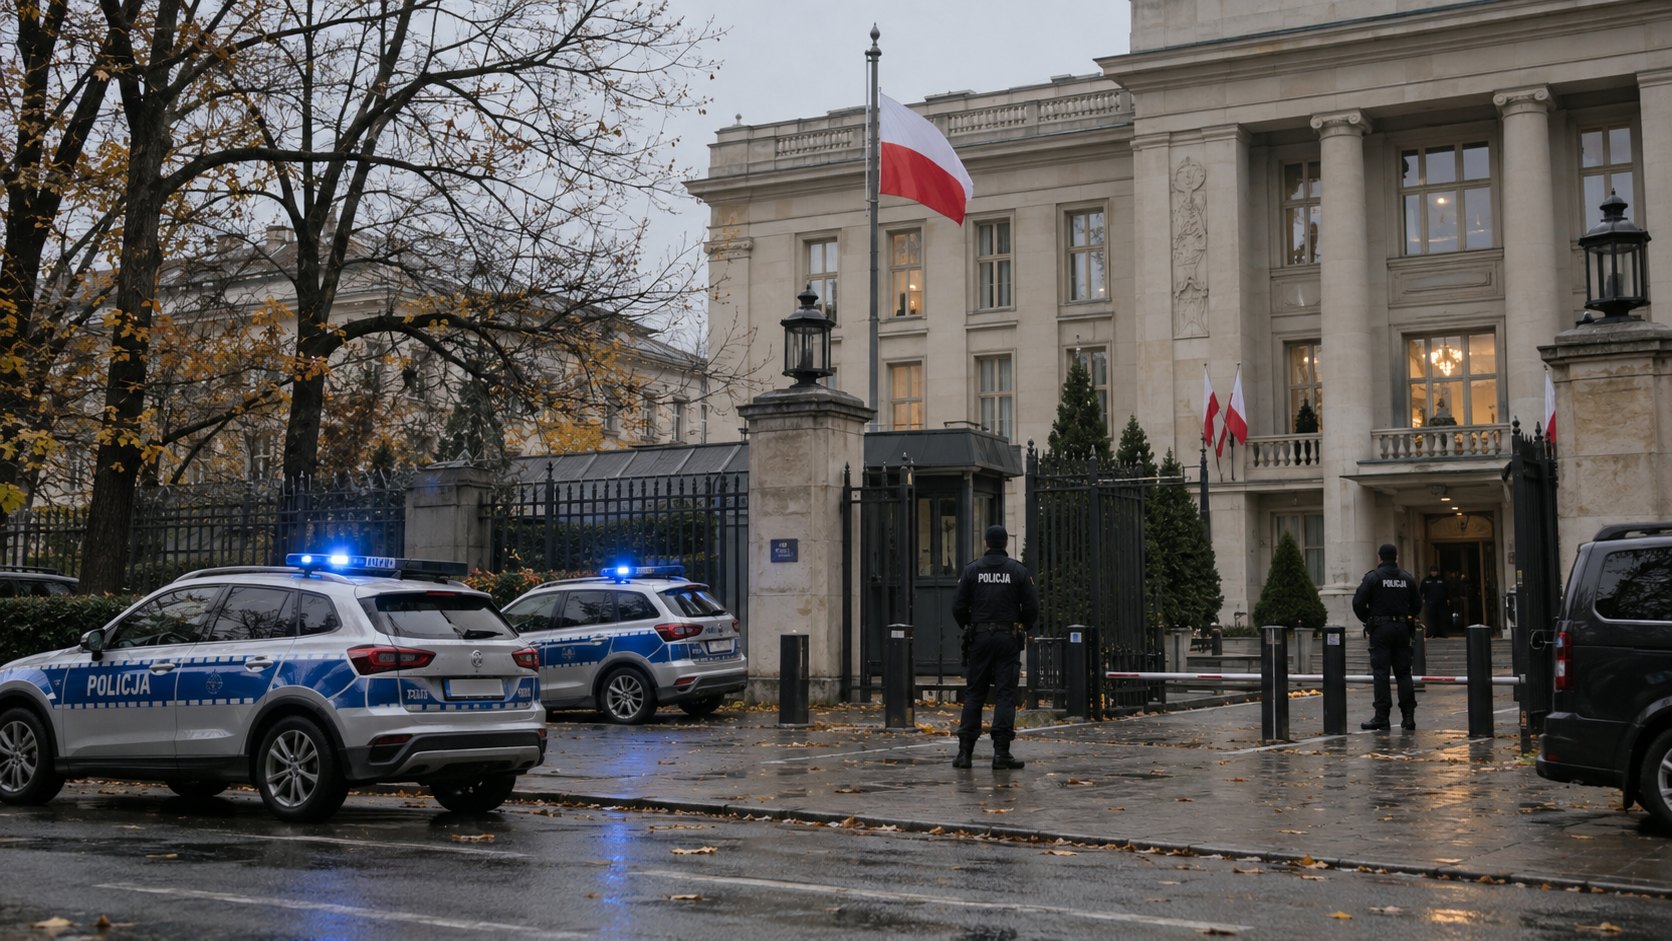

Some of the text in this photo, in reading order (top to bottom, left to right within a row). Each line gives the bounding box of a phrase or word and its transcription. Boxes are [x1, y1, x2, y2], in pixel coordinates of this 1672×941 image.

[978, 573, 1011, 584] POLICJA
[1382, 579, 1407, 588] POLICJA
[87, 672, 151, 697] POLICJA
